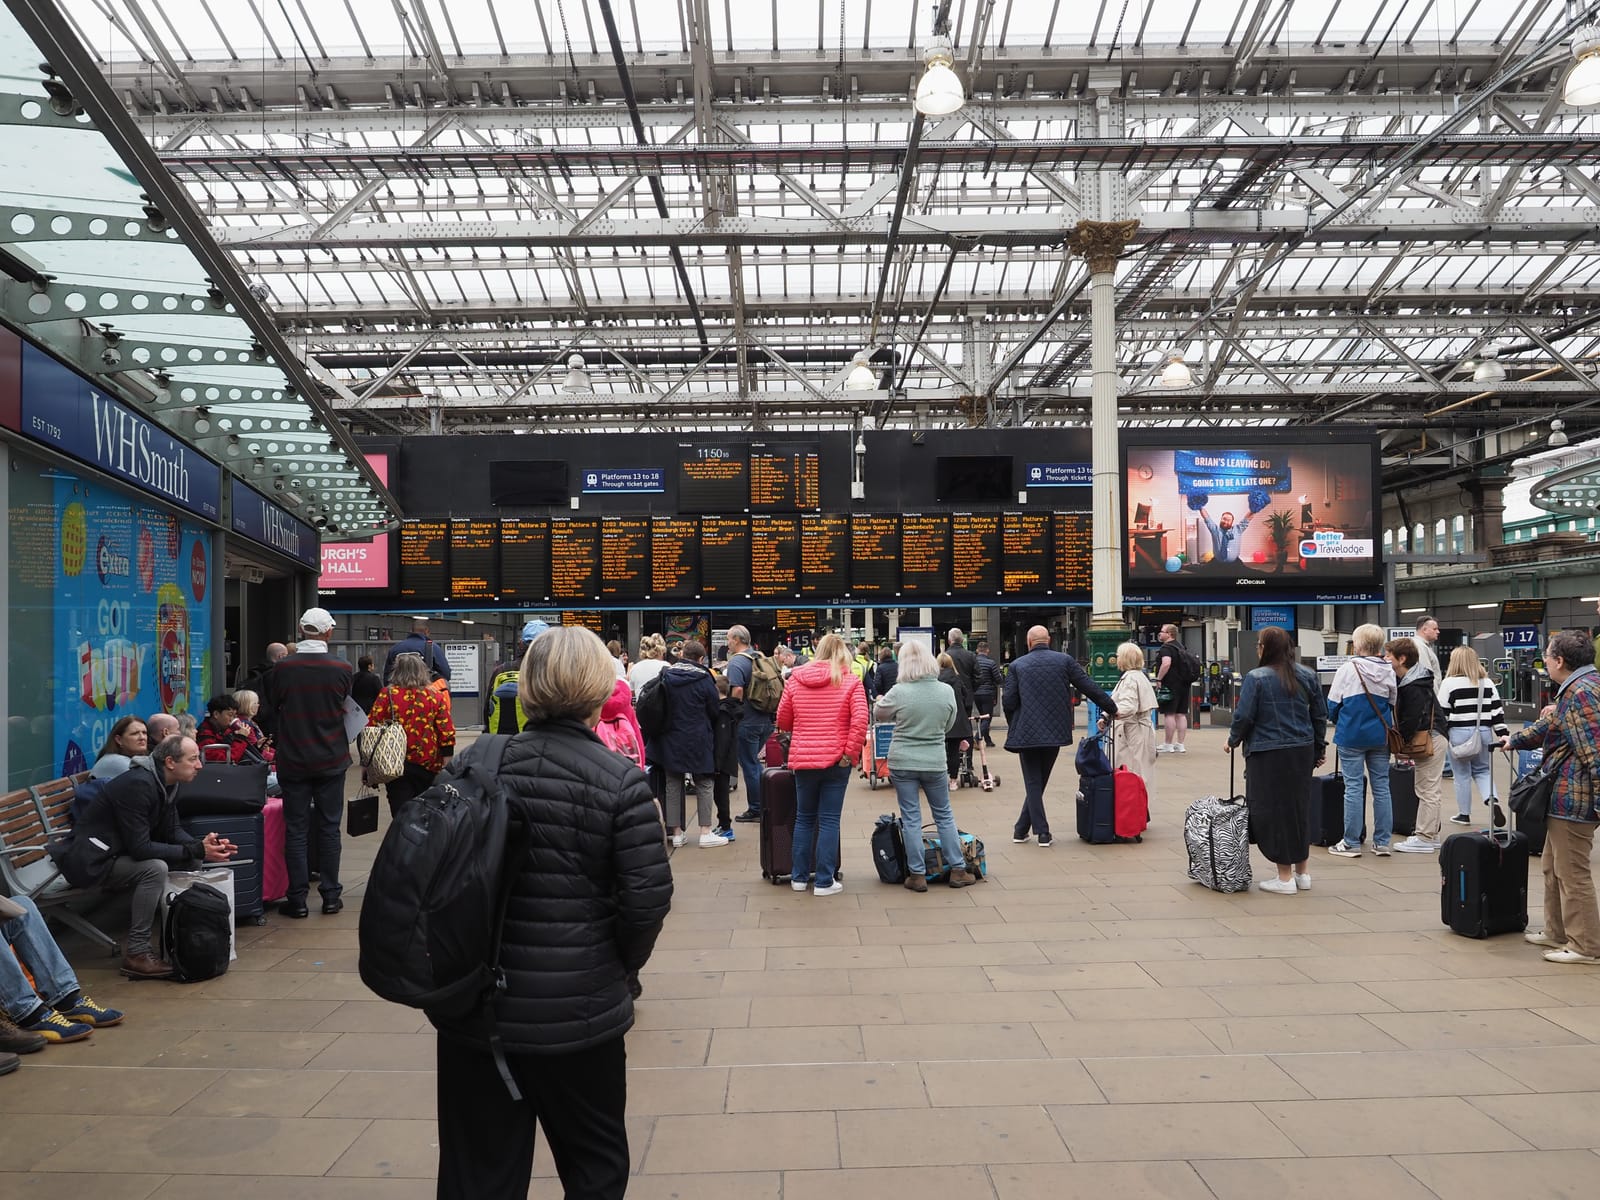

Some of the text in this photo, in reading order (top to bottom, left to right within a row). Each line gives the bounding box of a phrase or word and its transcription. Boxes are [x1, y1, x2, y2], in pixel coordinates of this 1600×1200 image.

[32, 416, 62, 440] EST 1792
[90, 391, 190, 503] WHSmith
[1194, 456, 1271, 469] BRIAN'S LEAVING DO
[601, 473, 632, 481] Platforms
[1192, 477, 1276, 488] GOING TO BE A LATE ONE?
[261, 501, 300, 557] WHSmith
[1315, 533, 1342, 541] Better
[1319, 543, 1364, 555] Travelodge
[100, 545, 129, 577] extra
[327, 562, 362, 574] HALL
[98, 598, 131, 636] GOT
[794, 635, 809, 647] 15
[1505, 631, 1534, 643] 17 17
[76, 638, 146, 710] FRUITY
